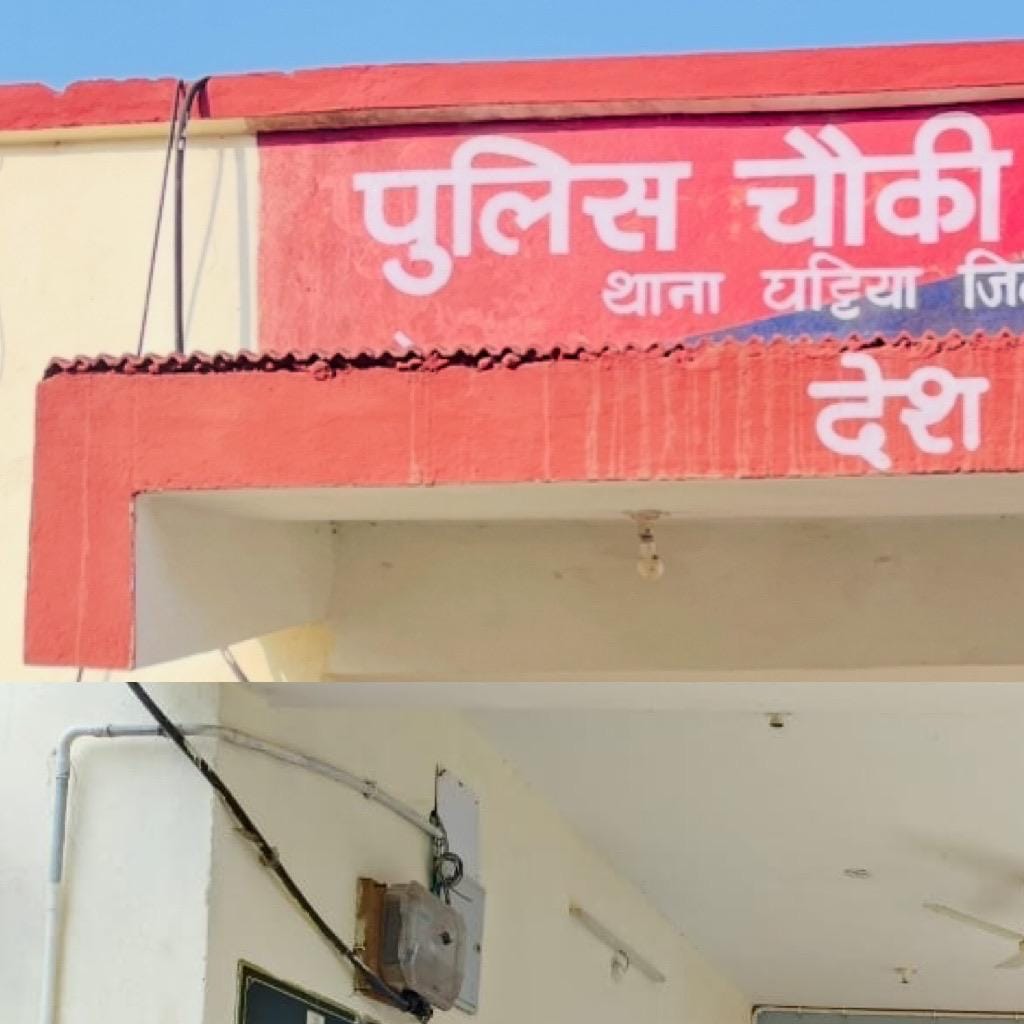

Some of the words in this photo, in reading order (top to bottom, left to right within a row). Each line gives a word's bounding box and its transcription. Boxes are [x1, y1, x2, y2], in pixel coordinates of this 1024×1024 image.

[353, 134, 692, 296] पुलिस
[602, 270, 726, 317] थाना
[807, 352, 989, 470] देश
